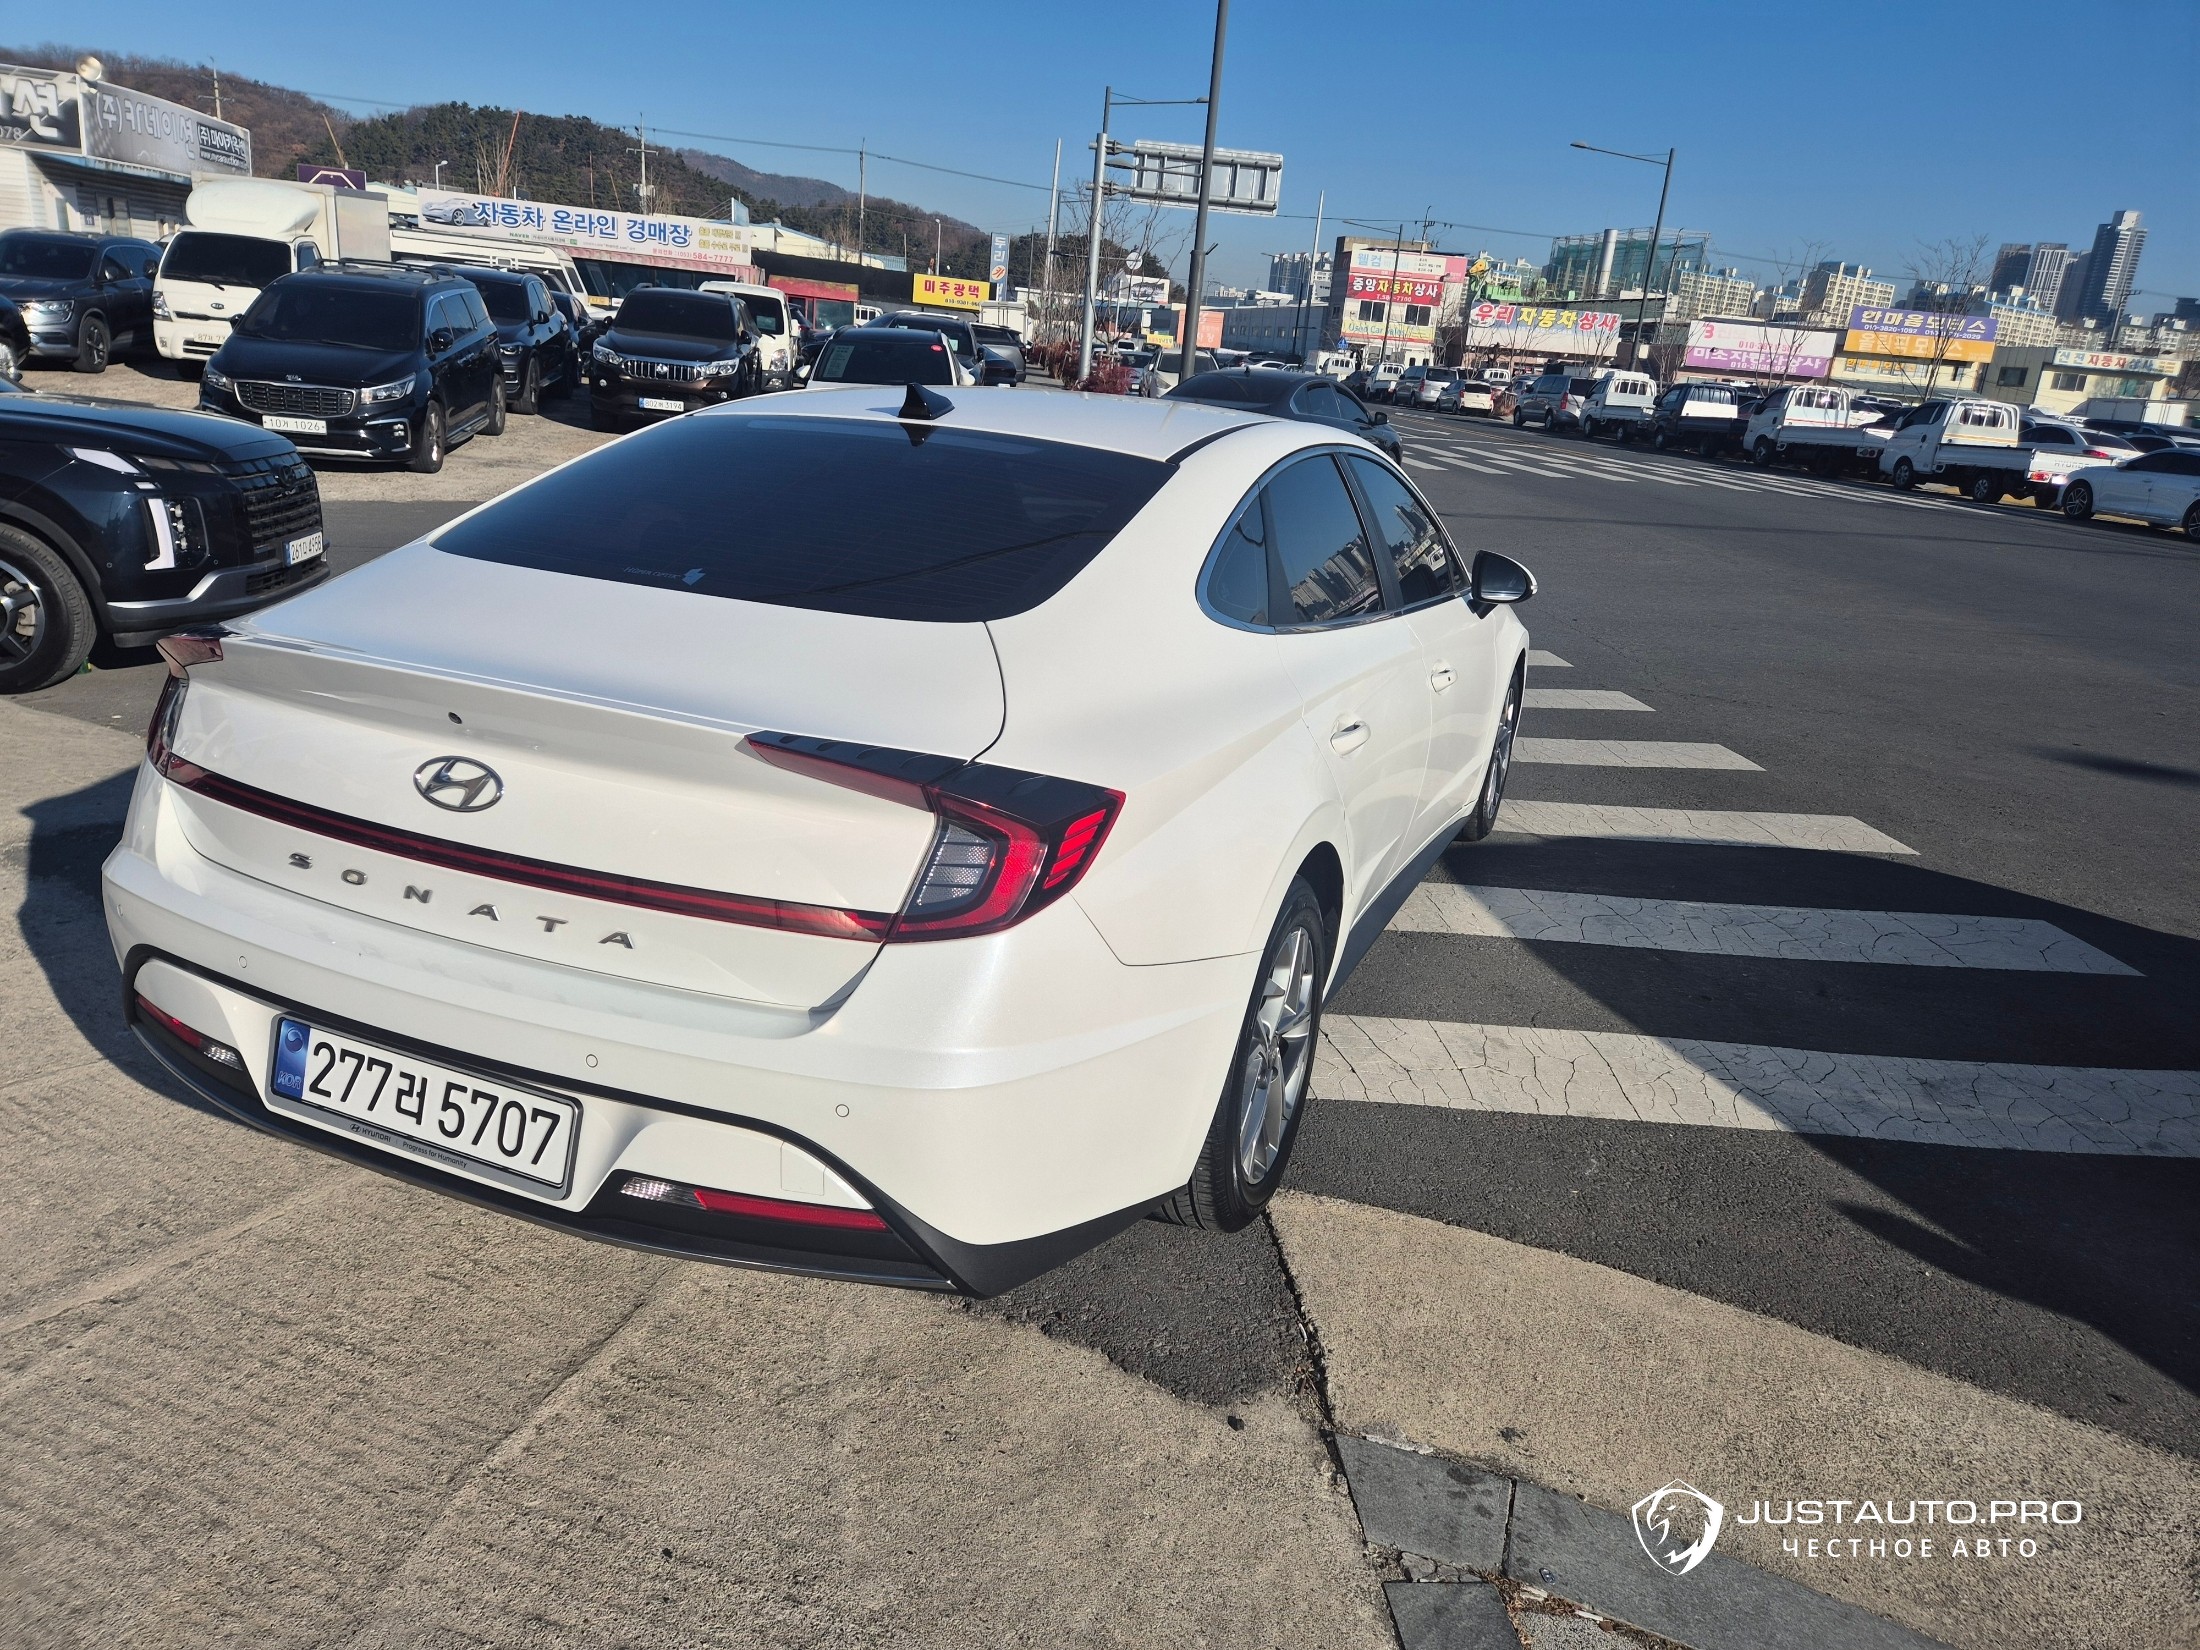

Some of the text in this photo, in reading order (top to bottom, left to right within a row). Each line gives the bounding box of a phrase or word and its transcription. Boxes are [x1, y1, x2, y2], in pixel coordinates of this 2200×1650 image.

[475, 201, 546, 231] 자동차
[551, 209, 618, 239] 온라인
[626, 218, 693, 247] 경매장
[924, 279, 980, 299] 미주광택
[294, 421, 320, 432] 1026
[288, 852, 634, 951] SONATA
[308, 1041, 561, 1165] 277러 5707
[362, 1128, 467, 1169] HYUNDAI Progress for Humanity
